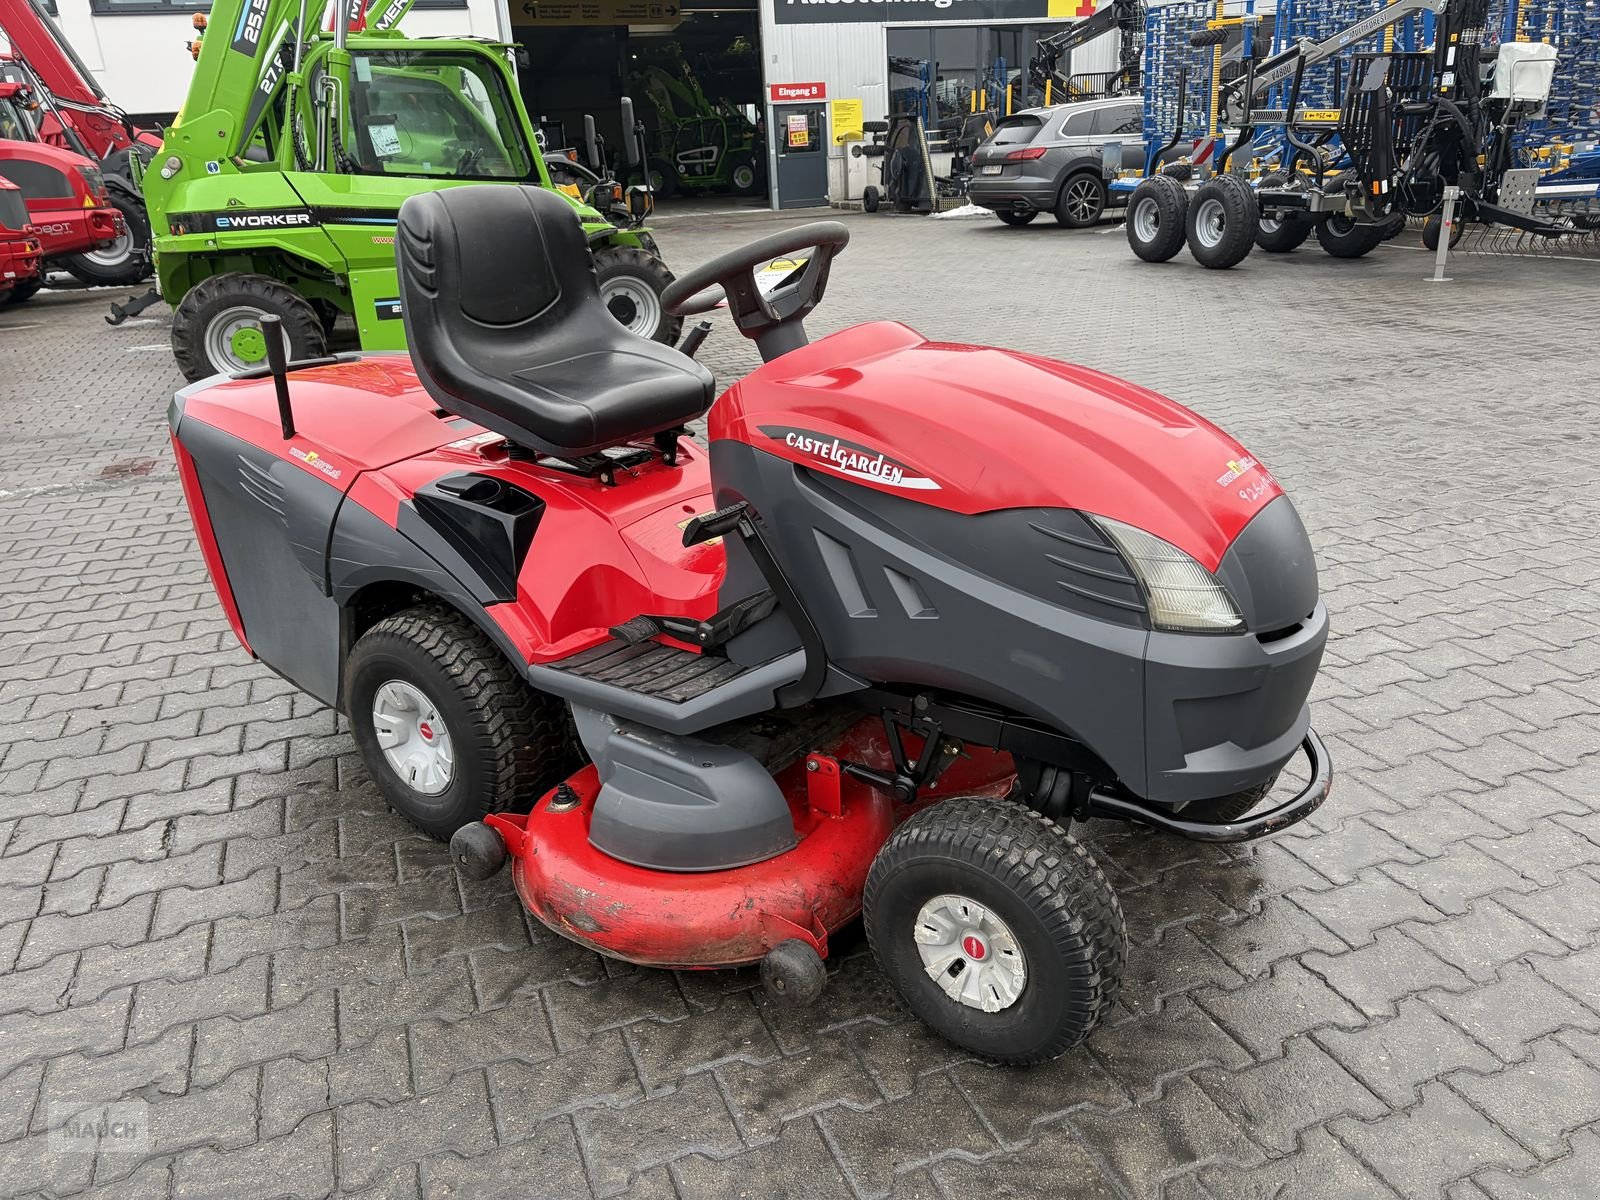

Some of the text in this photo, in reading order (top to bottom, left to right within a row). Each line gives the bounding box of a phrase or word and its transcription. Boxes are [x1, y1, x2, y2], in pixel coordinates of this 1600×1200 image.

[778, 86, 818, 97] Eingang B
[215, 213, 310, 228] eWORKER
